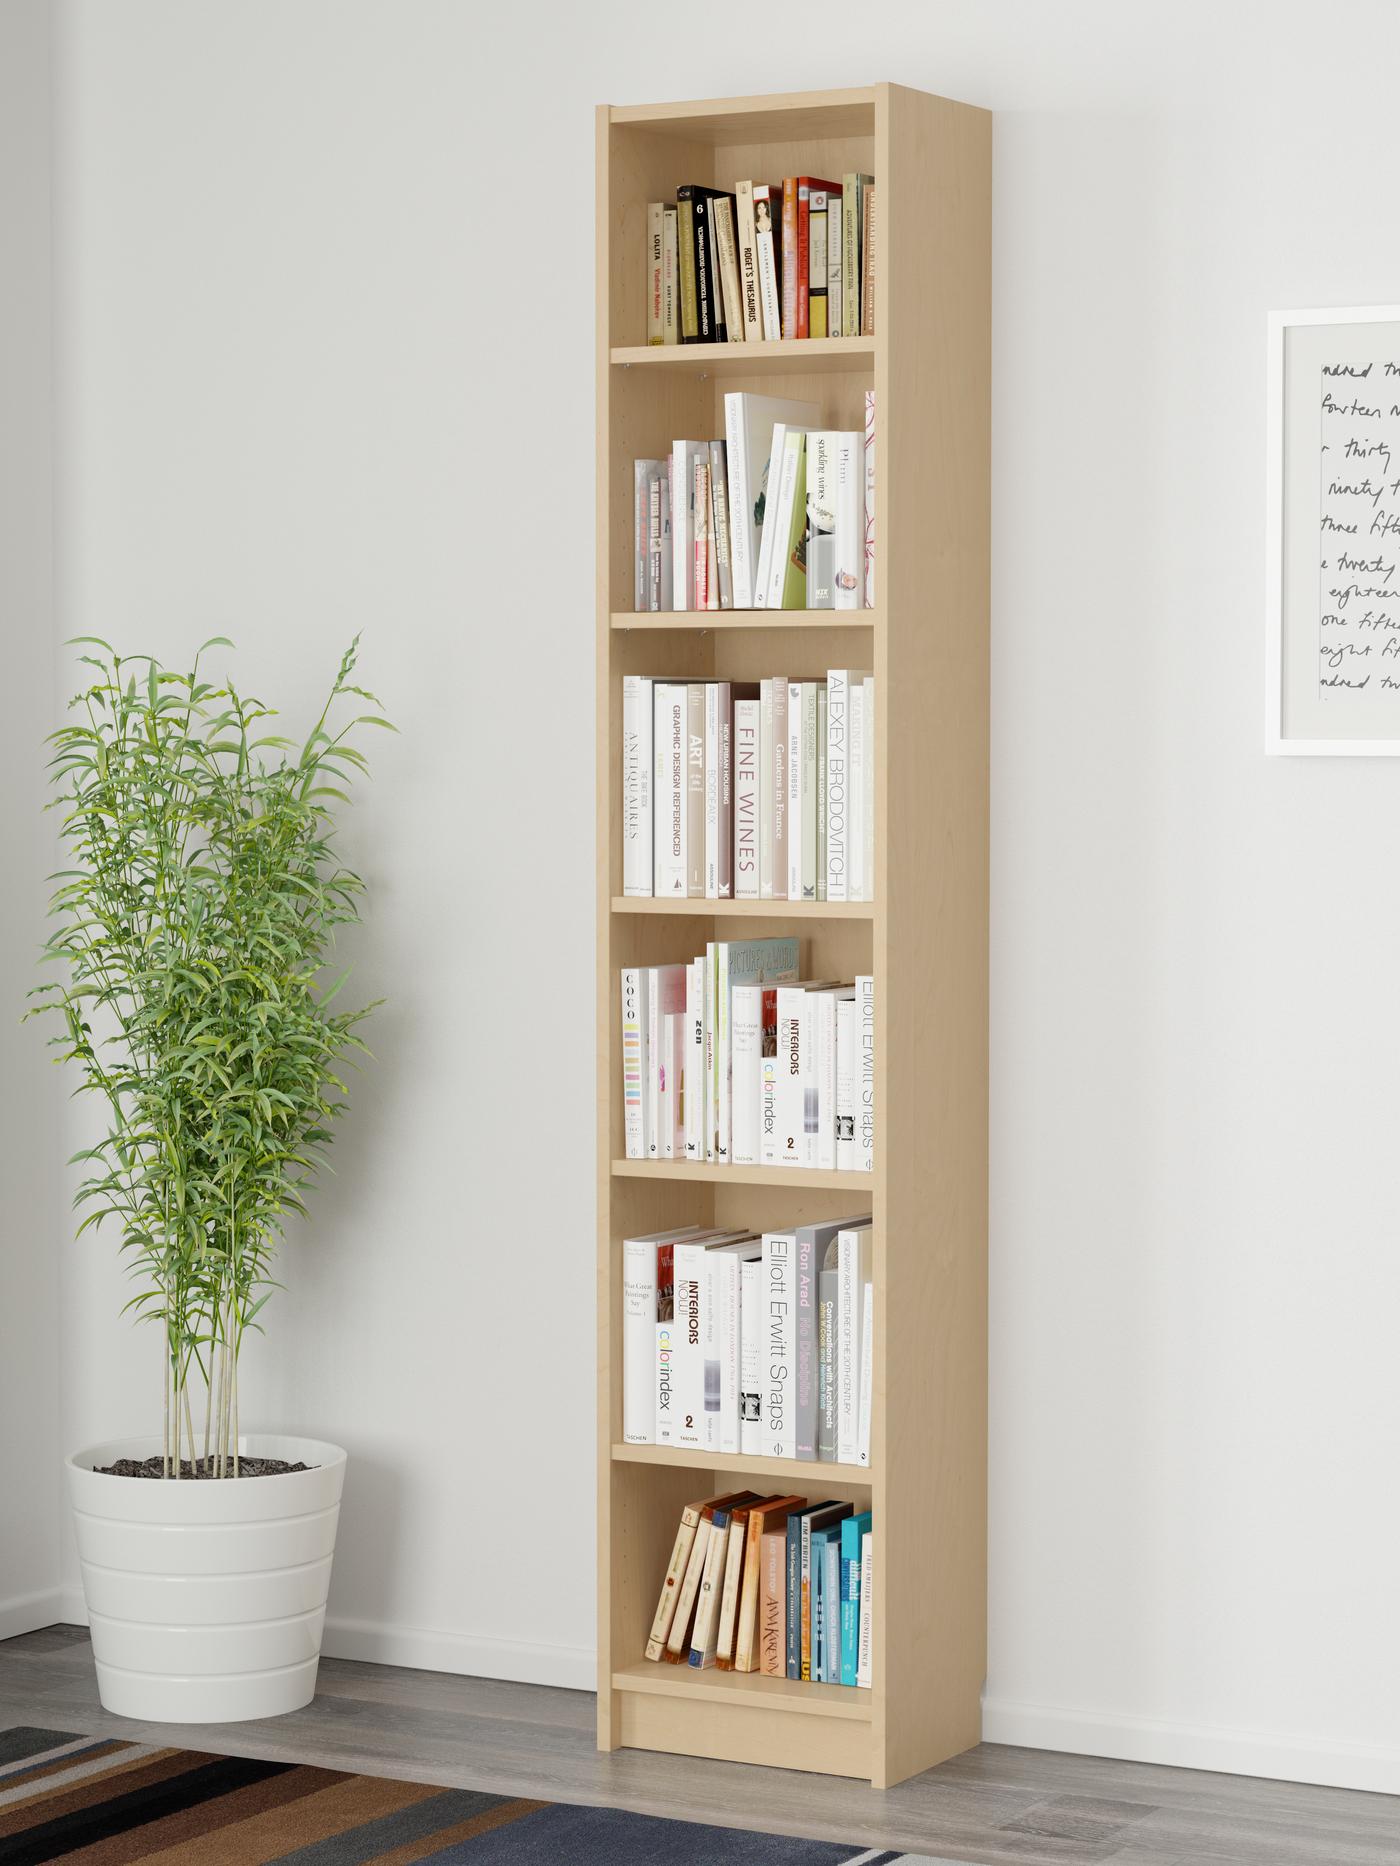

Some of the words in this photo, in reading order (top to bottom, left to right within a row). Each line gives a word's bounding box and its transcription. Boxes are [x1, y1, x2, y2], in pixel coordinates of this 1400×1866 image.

[696, 204, 703, 214] 6
[744, 247, 755, 278] ROGET'S
[746, 280, 756, 322] THESAURUS
[1321, 393, 1382, 419] fourteen
[817, 439, 828, 474] sparkling
[1344, 438, 1391, 475] thirty
[818, 477, 827, 500] wines
[1328, 476, 1385, 508] ninety
[1320, 514, 1358, 534] three
[1338, 552, 1396, 584] twenty
[1321, 614, 1348, 626] one
[1320, 643, 1373, 668] eight
[672, 704, 681, 749] GRAPHIC
[829, 675, 845, 752] ALEXEY
[689, 734, 704, 769] ART
[739, 727, 755, 781] FINE
[807, 722, 815, 761] DESIGNERS
[672, 752, 681, 789] DESIGN
[775, 743, 785, 788] Gardens
[627, 732, 639, 841] ANTIQUAIRES
[775, 789, 785, 800] in
[672, 791, 681, 857] REFERENCED
[739, 792, 755, 872] WINES
[775, 802, 785, 840] France
[829, 760, 845, 886] BRODOVITCH
[695, 1020, 703, 1045] zen
[790, 1019, 800, 1075] INTERIORS
[764, 1064, 776, 1135] colorindex
[787, 1137, 795, 1149] 2
[769, 1240, 788, 1294] Elliott
[800, 1242, 810, 1270] Ron
[843, 1239, 851, 1273] VISIONARY
[677, 1279, 689, 1316] NOW!
[800, 1274, 810, 1307] Arad
[843, 1274, 851, 1329] ARCHITECTURE
[688, 1280, 699, 1345] INTERIORS
[769, 1300, 788, 1358] Erwitt
[800, 1317, 810, 1337] No
[825, 1300, 834, 1362] Conversations
[843, 1330, 851, 1339] OF
[843, 1340, 851, 1355] THE
[659, 1330, 673, 1411] colorindex
[798, 1341, 811, 1407] Discipline
[825, 1364, 834, 1384] with
[843, 1356, 851, 1378] 20TH
[766, 1364, 788, 1431] Snaps
[825, 1385, 834, 1429] Architects
[843, 1379, 851, 1415] CENTURY
[685, 1415, 693, 1429] 2
[769, 1537, 777, 1554] LEO
[769, 1557, 777, 1594] TOLSTOY
[849, 1559, 861, 1601] difficult
[764, 1594, 780, 1626] ANNA
[861, 1612, 870, 1668] COUNTERPUNCH
